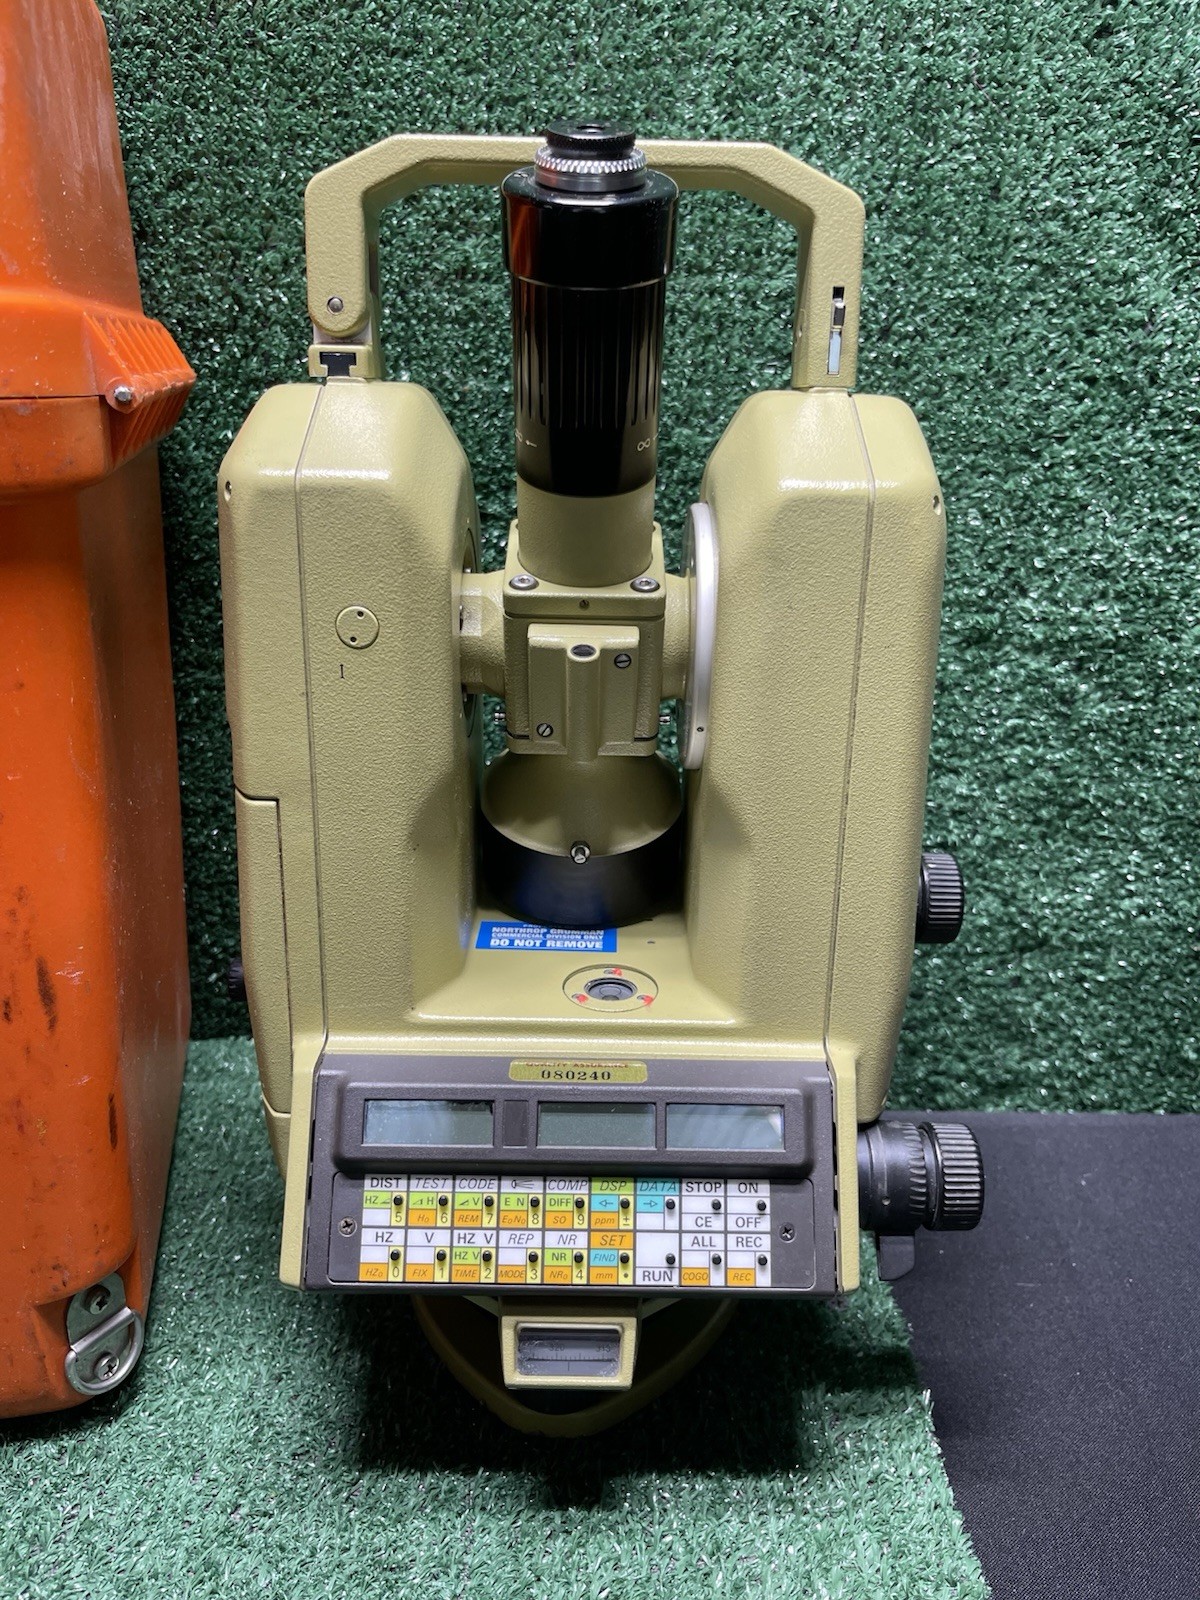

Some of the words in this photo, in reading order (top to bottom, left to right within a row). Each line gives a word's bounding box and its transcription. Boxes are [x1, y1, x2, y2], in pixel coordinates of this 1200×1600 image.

[490, 938, 510, 947] DO
[513, 939, 543, 947] NOT
[546, 940, 603, 949] REMOVE
[541, 1069, 611, 1080] 080240
[370, 1177, 402, 1188] DIST
[415, 1178, 449, 1189] TEST
[458, 1178, 496, 1190] CODE
[547, 1179, 588, 1190] COMP
[600, 1180, 627, 1191] DSP
[639, 1181, 676, 1192] DATA
[685, 1181, 722, 1193] STOP
[738, 1182, 759, 1193] ON
[365, 1195, 378, 1204] HZ
[426, 1197, 434, 1205] H
[472, 1198, 480, 1206] V
[504, 1198, 511, 1206] E
[516, 1198, 525, 1206] N
[549, 1198, 571, 1207] DIFF
[395, 1211, 402, 1223] 5
[440, 1212, 448, 1224] 6
[458, 1215, 479, 1223] REM
[486, 1213, 493, 1224] 7
[532, 1213, 540, 1225] 8
[577, 1214, 585, 1226] 9
[595, 1216, 615, 1226] ppm
[695, 1216, 712, 1228] CE
[735, 1217, 761, 1228] OFF
[375, 1231, 394, 1243] HZ
[425, 1232, 434, 1244] V
[457, 1232, 476, 1244] HZ
[484, 1233, 494, 1245] V
[508, 1233, 535, 1245] REP
[557, 1233, 578, 1245] NR
[600, 1234, 626, 1246] SET
[691, 1235, 716, 1248] ALL
[736, 1236, 763, 1248] REC
[454, 1251, 468, 1260] HZ
[472, 1251, 480, 1260] V
[551, 1252, 567, 1261] NR
[593, 1253, 616, 1262] FIND
[392, 1266, 400, 1278] 0
[412, 1269, 428, 1277] FIX
[439, 1267, 445, 1279] 1
[455, 1269, 477, 1278] TIME
[484, 1267, 492, 1279] 2
[499, 1270, 525, 1279] MODE
[530, 1268, 538, 1280] 3
[575, 1269, 584, 1281] 4
[595, 1272, 614, 1280] mm
[642, 1270, 673, 1282] RUN
[682, 1272, 708, 1281] COGO
[732, 1273, 752, 1282] REC
